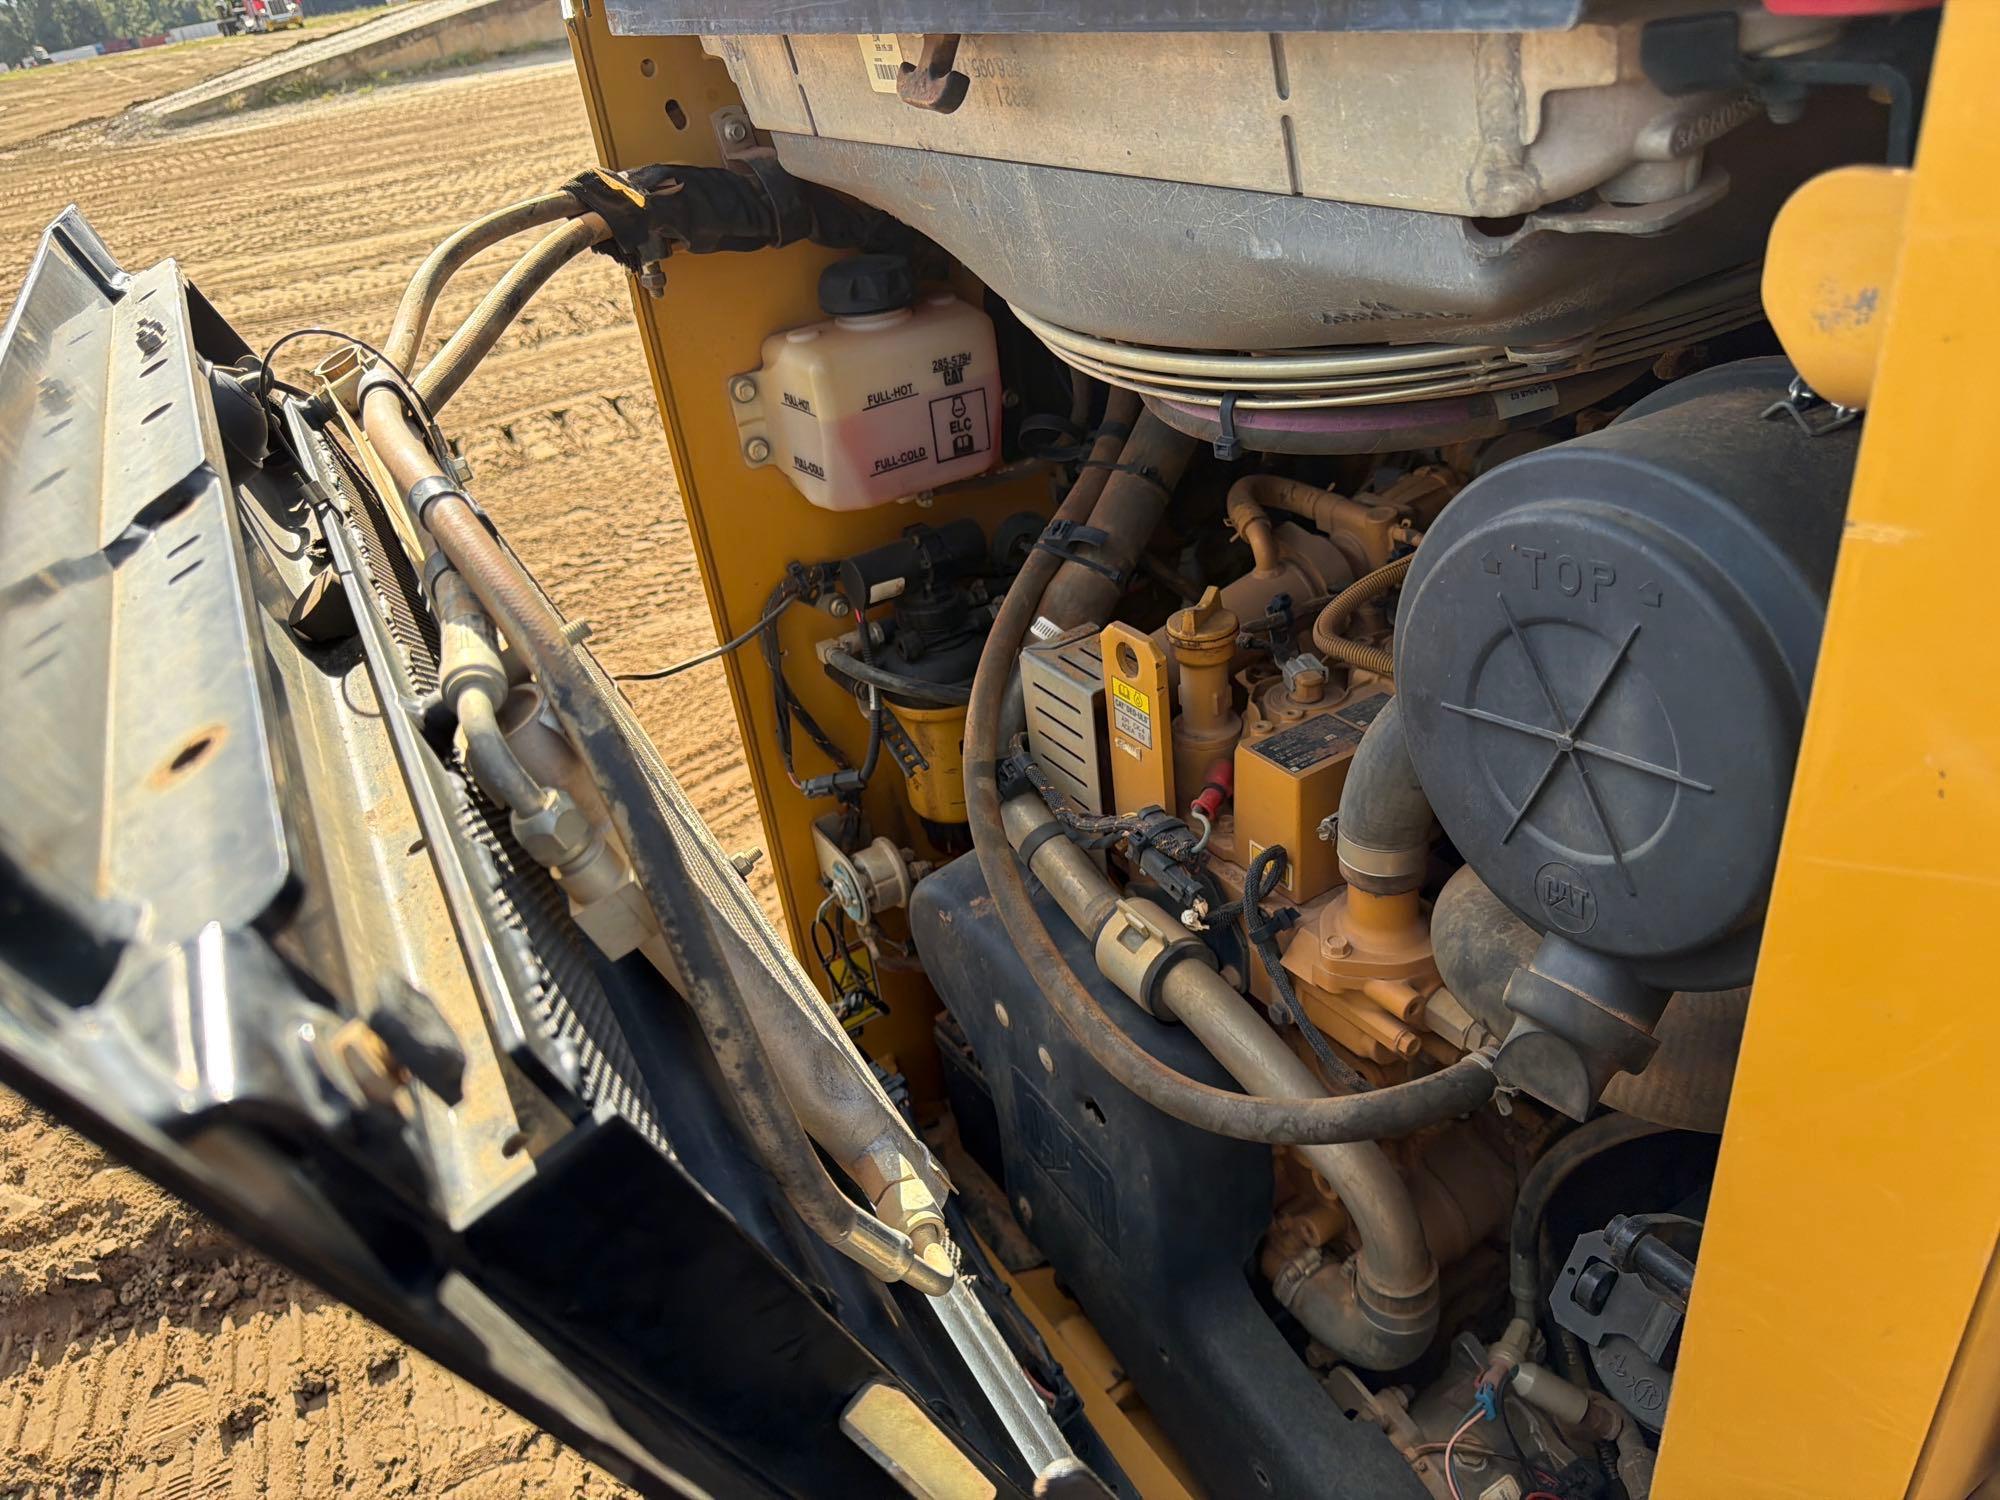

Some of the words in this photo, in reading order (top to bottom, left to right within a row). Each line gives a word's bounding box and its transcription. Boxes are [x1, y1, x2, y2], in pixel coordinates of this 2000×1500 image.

[943, 367, 963, 386] CAT
[784, 392, 810, 412] FULL-HOT
[867, 383, 913, 406] FULL-HOT
[949, 417, 972, 435] ELC
[794, 456, 824, 477] FULL-COLD
[874, 447, 926, 472] FULL-COLD
[1521, 546, 1617, 603] TOP
[1543, 875, 1590, 920] CAT
